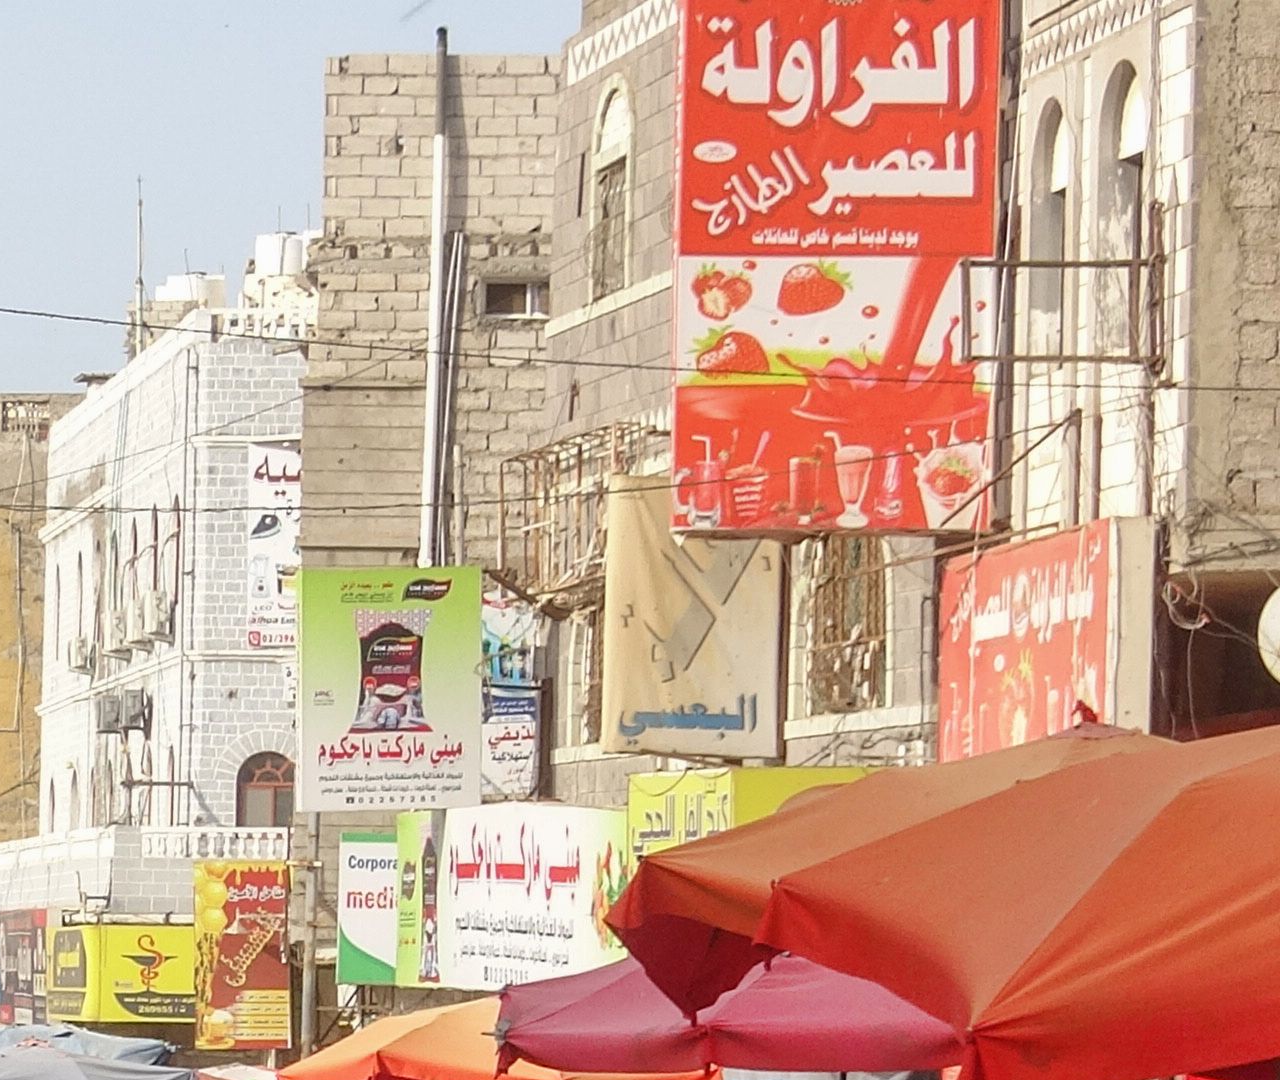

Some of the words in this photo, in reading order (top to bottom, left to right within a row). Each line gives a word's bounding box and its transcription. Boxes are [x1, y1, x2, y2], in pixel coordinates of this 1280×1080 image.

[701, 17, 976, 128] الفراولة
[807, 131, 976, 216] للعصير
[691, 145, 810, 236] الطازج
[800, 227, 830, 248] خاص
[832, 227, 858, 249] قسم
[859, 227, 888, 249] لدينا
[888, 229, 920, 249] يوجد
[318, 734, 373, 767] باحكوم
[377, 734, 425, 764] ماركت
[430, 734, 463, 767] ميني
[488, 725, 535, 749] ذيفي
[495, 822, 540, 898] ماركت
